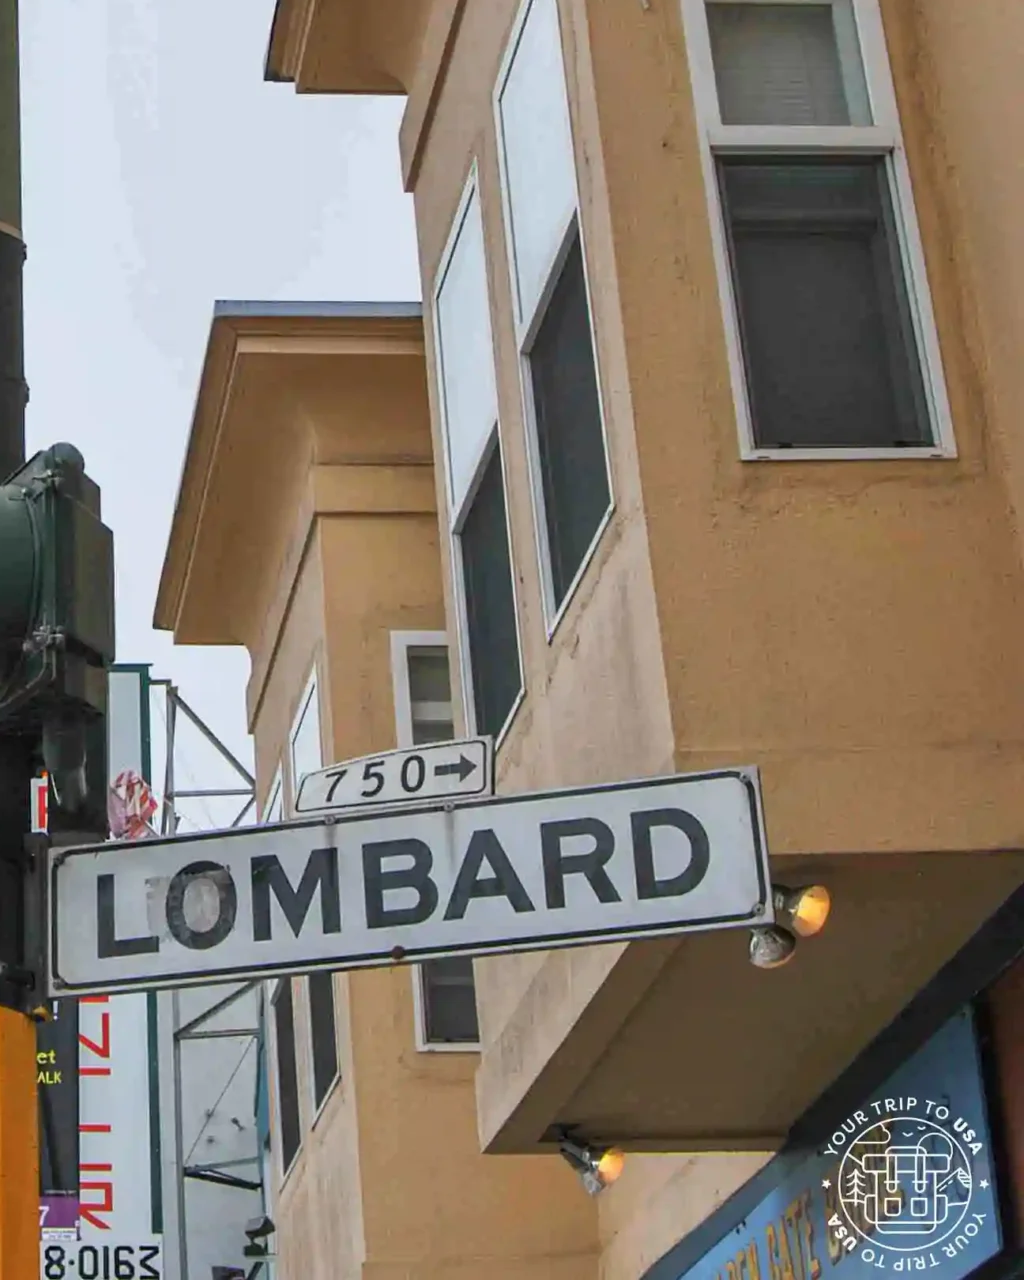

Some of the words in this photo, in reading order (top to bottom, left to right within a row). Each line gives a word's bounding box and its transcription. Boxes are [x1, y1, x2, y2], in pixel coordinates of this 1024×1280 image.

[324, 754, 426, 803] 750
[95, 806, 711, 960] LOMBARD
[36, 1049, 56, 1064] et
[36, 1070, 62, 1084] ALK
